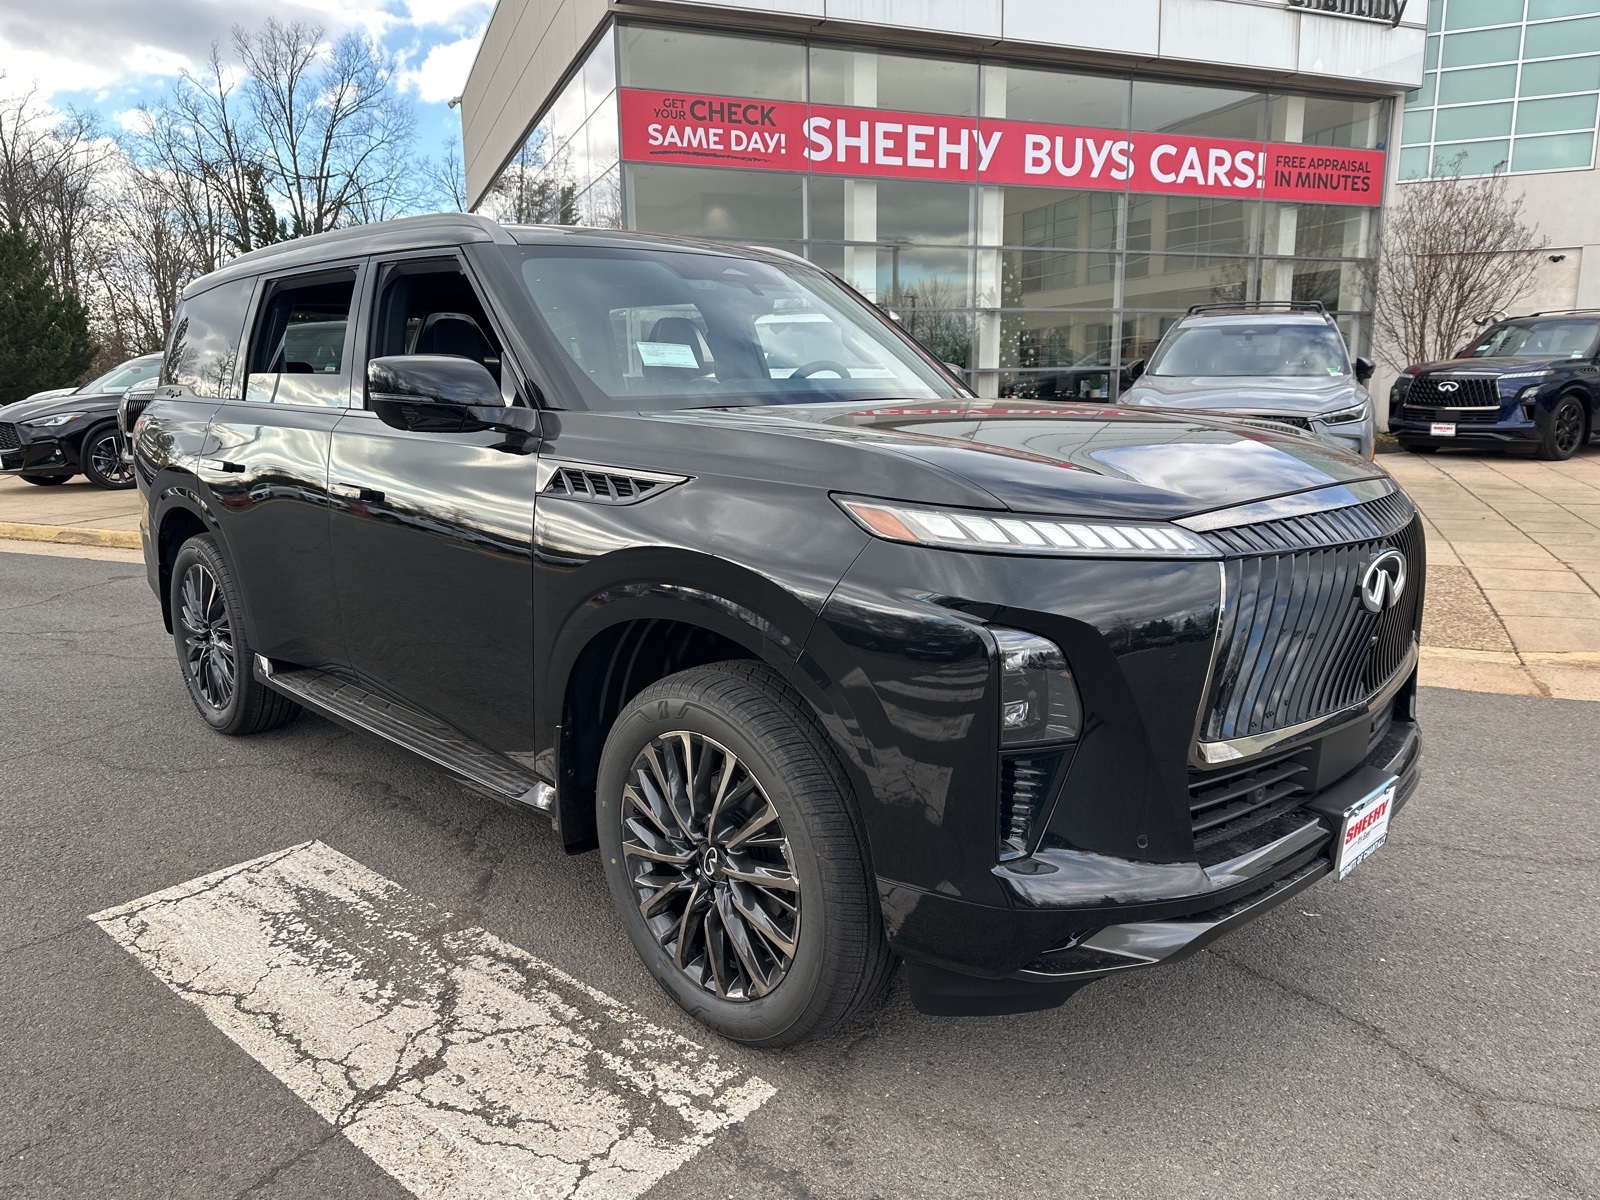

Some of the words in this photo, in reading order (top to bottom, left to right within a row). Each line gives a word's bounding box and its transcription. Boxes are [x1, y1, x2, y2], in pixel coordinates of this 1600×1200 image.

[653, 108, 686, 120] YOUR
[662, 98, 685, 109] GET
[689, 100, 776, 127] CHECK
[647, 124, 724, 150] SAME
[730, 130, 786, 154] DAY!
[802, 117, 1003, 171] SHEEHY
[1024, 134, 1134, 181] BUYS
[1150, 144, 1266, 188] CARS!
[1276, 155, 1306, 169] FREE
[1307, 158, 1372, 174] APPRAISAL
[1274, 170, 1293, 187] IN
[1295, 171, 1371, 193] MINUTES
[1345, 799, 1389, 845] SHEEHY
